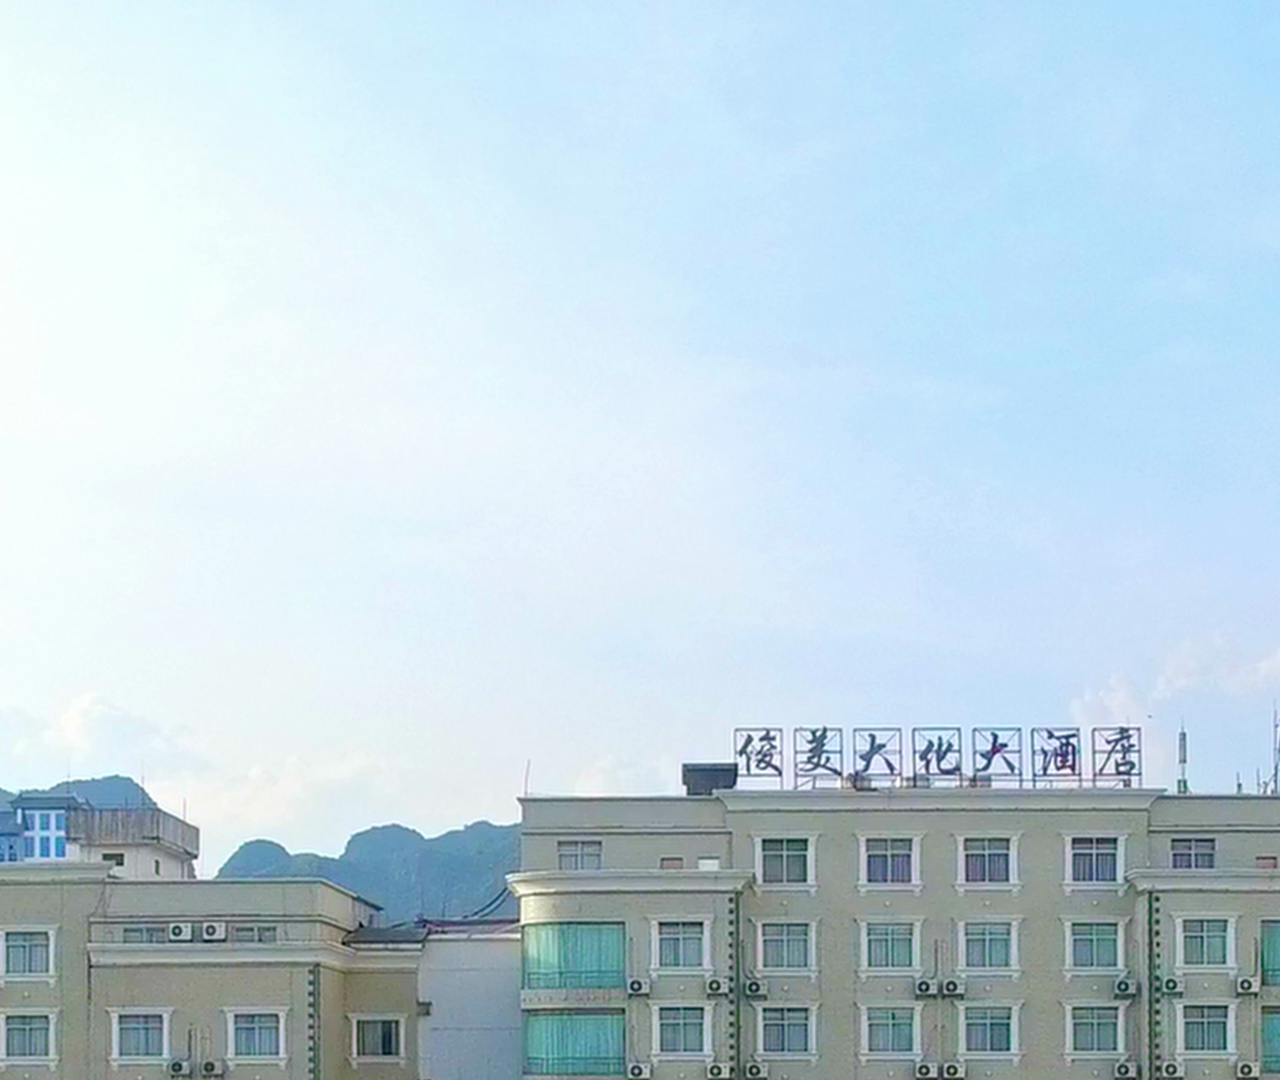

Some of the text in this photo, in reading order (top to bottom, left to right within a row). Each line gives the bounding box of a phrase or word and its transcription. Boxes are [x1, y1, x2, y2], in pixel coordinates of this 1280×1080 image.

[738, 726, 1136, 776] 俊美大化大酒店
